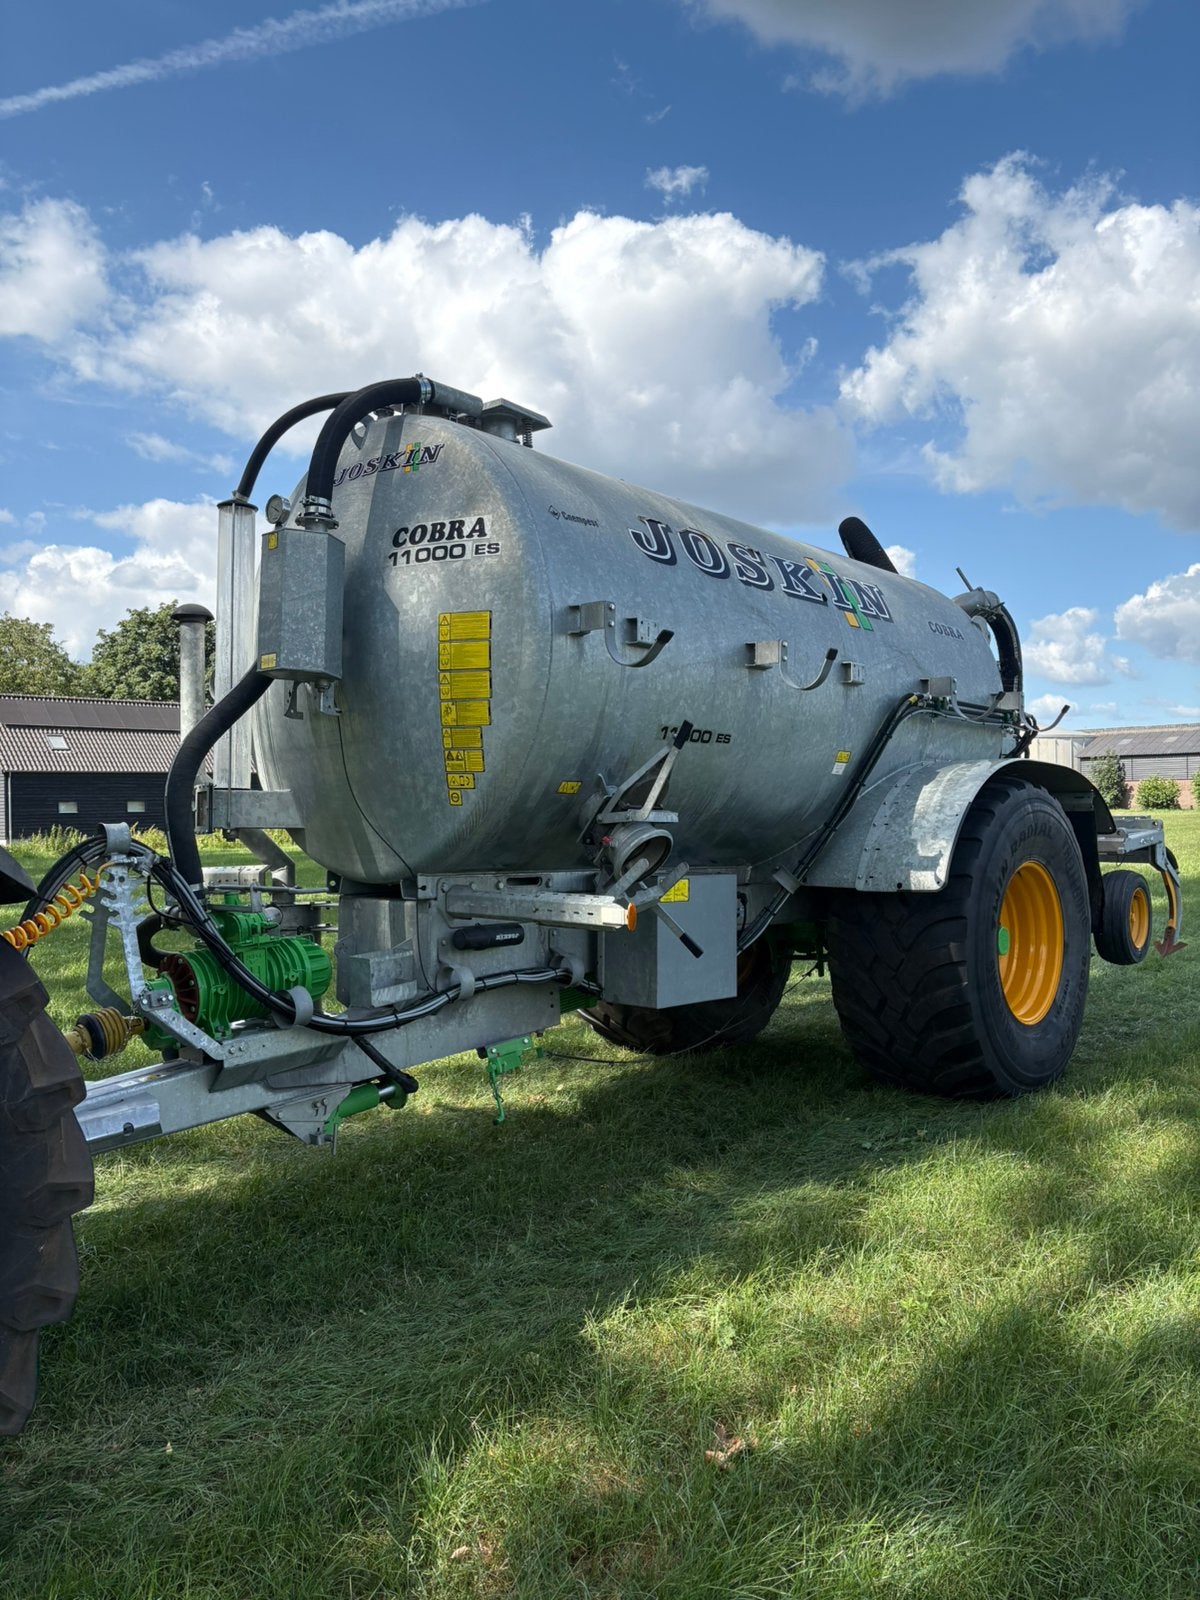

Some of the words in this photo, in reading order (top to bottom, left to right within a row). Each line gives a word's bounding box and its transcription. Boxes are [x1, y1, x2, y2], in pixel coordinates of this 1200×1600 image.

[333, 443, 445, 487] JOSKIN
[392, 517, 487, 548] COBRA
[388, 543, 466, 566] 11000
[474, 542, 500, 556] ES
[628, 515, 894, 623] JOSKIN
[928, 621, 964, 640] COBRA
[661, 726, 712, 744] 1100
[715, 733, 731, 744] ES
[1010, 823, 1053, 857] RADIAL
